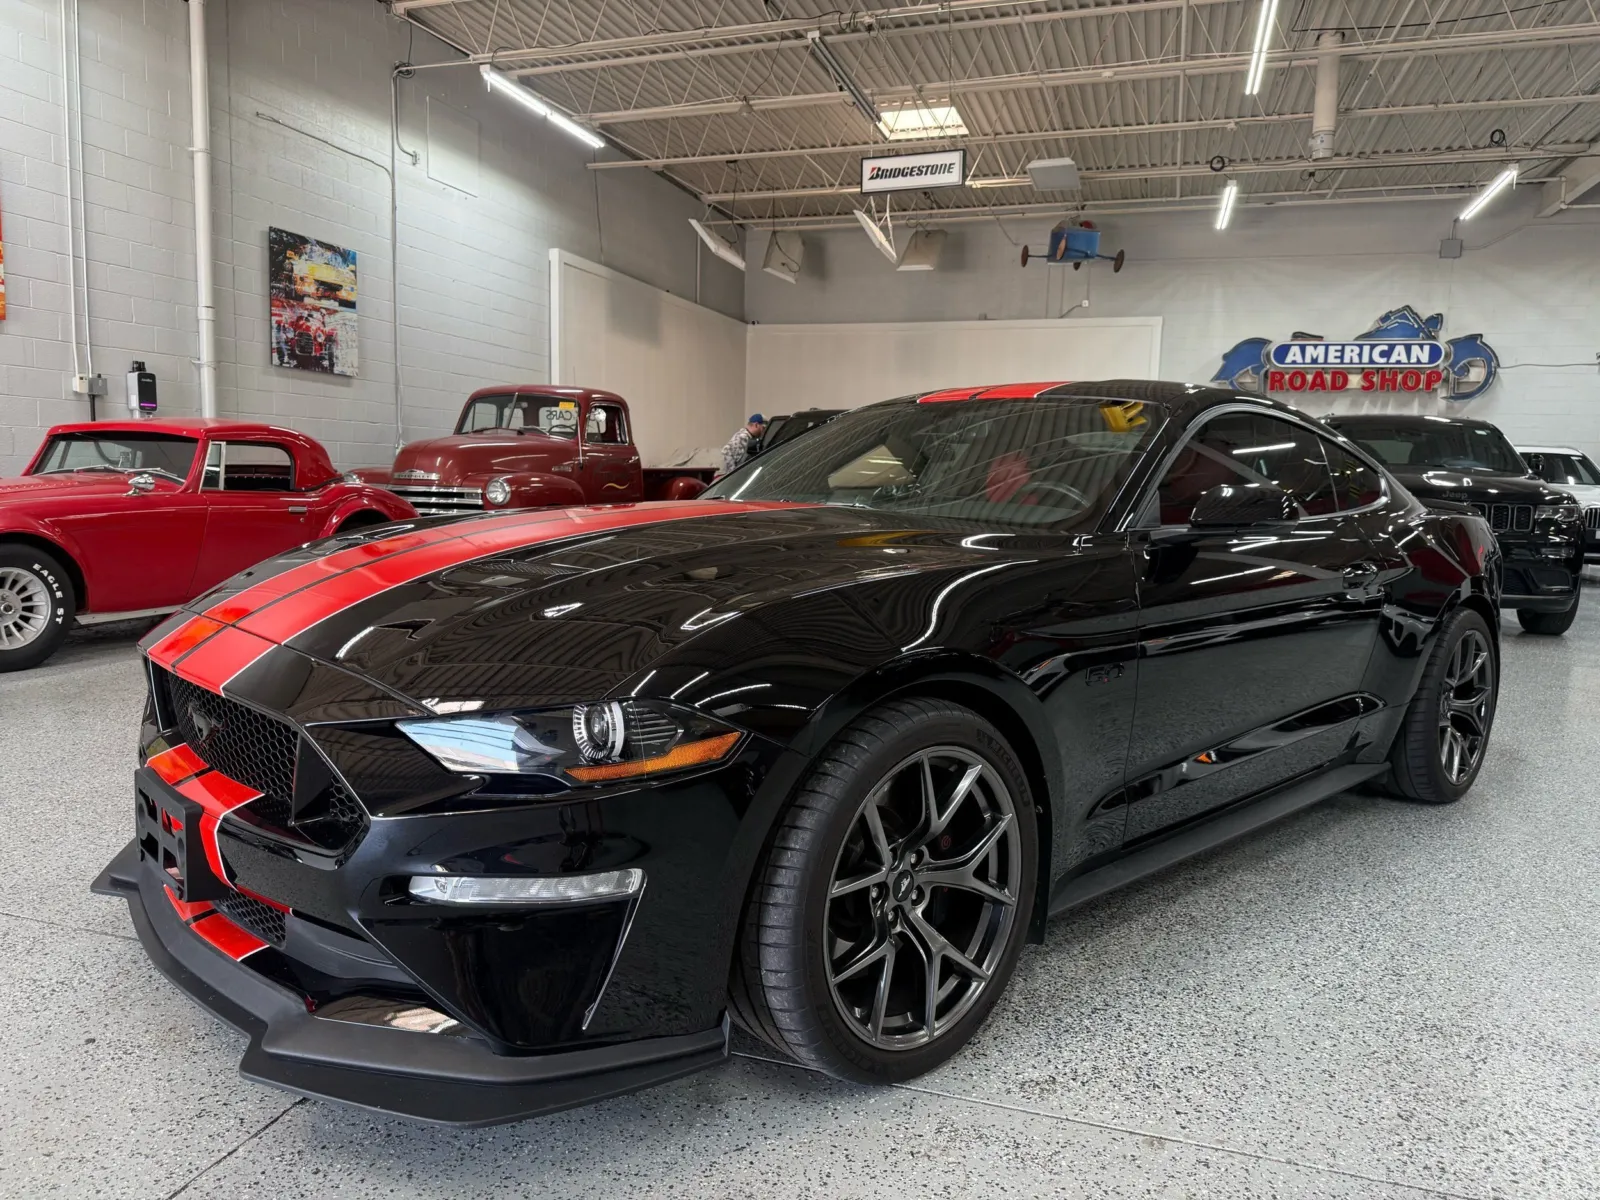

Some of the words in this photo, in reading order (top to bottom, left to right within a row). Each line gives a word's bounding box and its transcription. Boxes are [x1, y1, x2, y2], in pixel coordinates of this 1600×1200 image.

[868, 163, 956, 180] BRIDGESTONE
[1284, 344, 1432, 364] AMERICAN
[1268, 369, 1349, 392] ROAD
[1360, 369, 1443, 392] SHOP
[32, 563, 64, 599] EAGLE
[55, 607, 65, 625] ST
